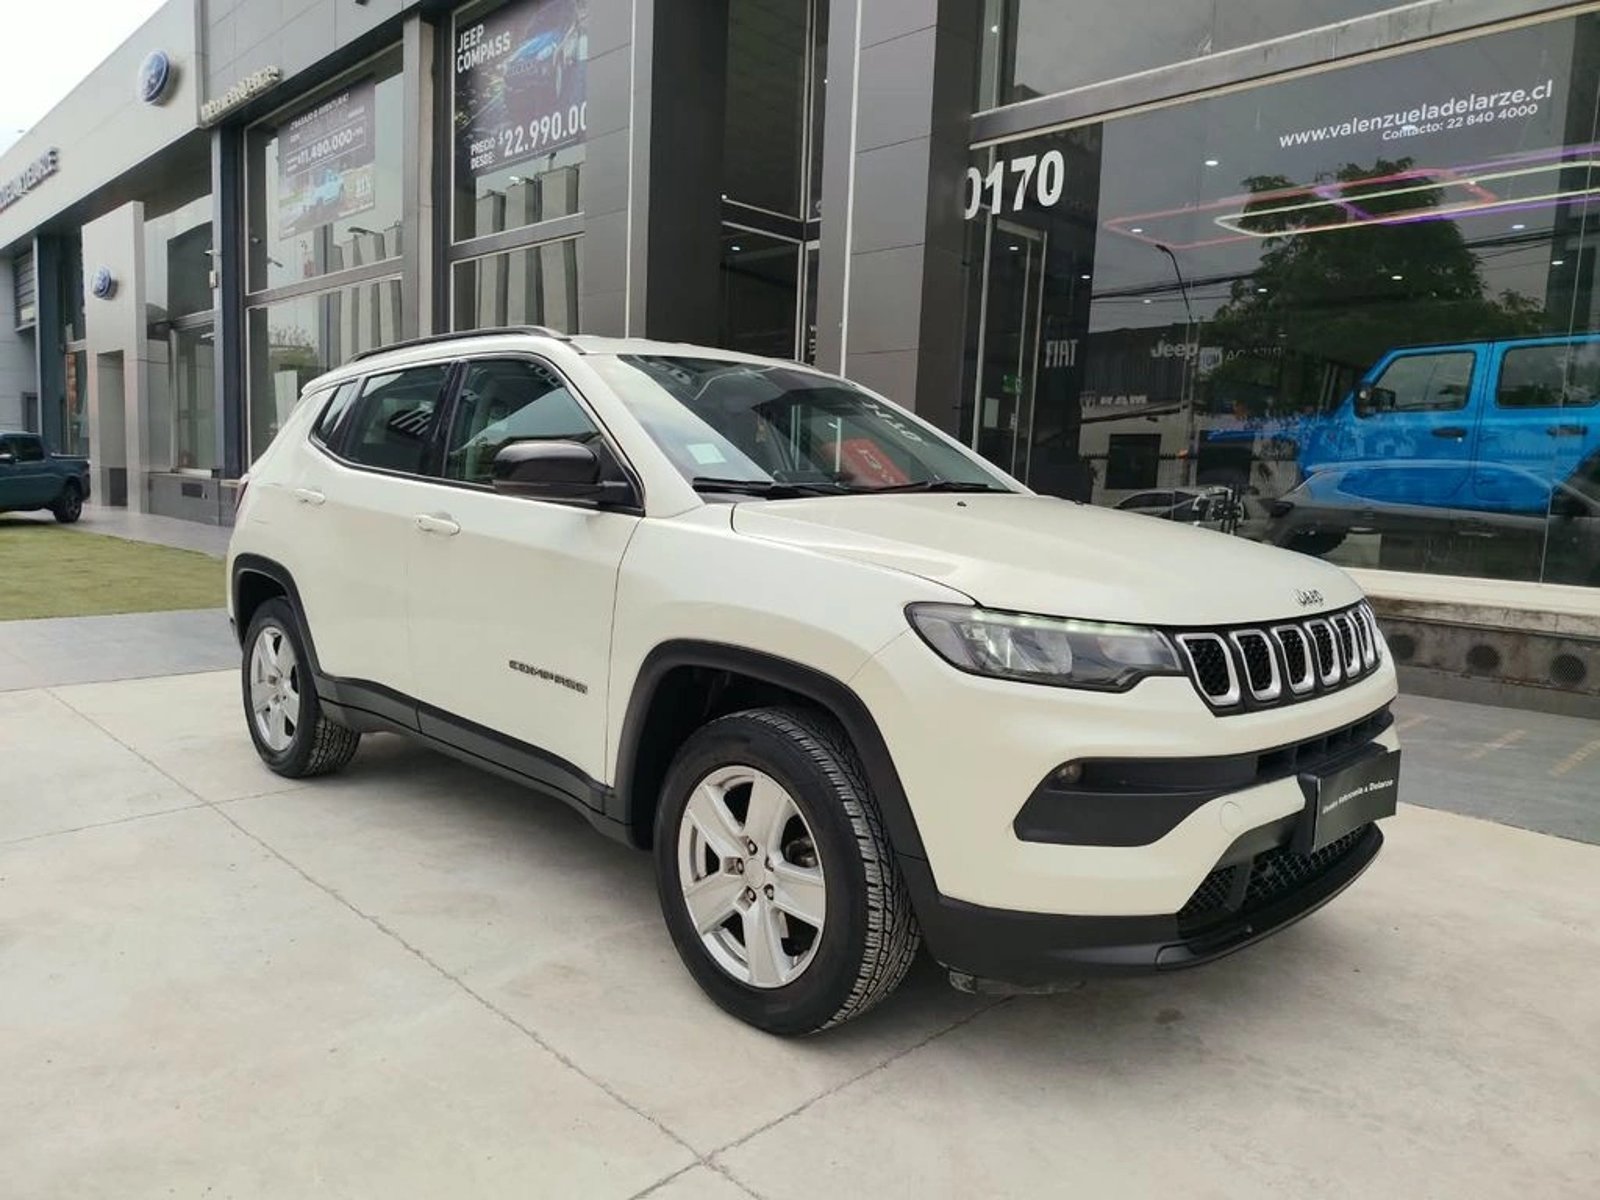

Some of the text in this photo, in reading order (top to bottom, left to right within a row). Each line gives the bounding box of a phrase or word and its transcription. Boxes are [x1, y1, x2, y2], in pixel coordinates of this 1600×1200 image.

[457, 24, 484, 53] JEEP
[457, 31, 511, 74] COMPASS
[1279, 80, 1553, 148] www.valenzueladelarze.cl
[1382, 103, 1538, 141] Contacto: 22 840 4000
[1044, 339, 1079, 368] FIAT
[1150, 340, 1198, 361] Jeep
